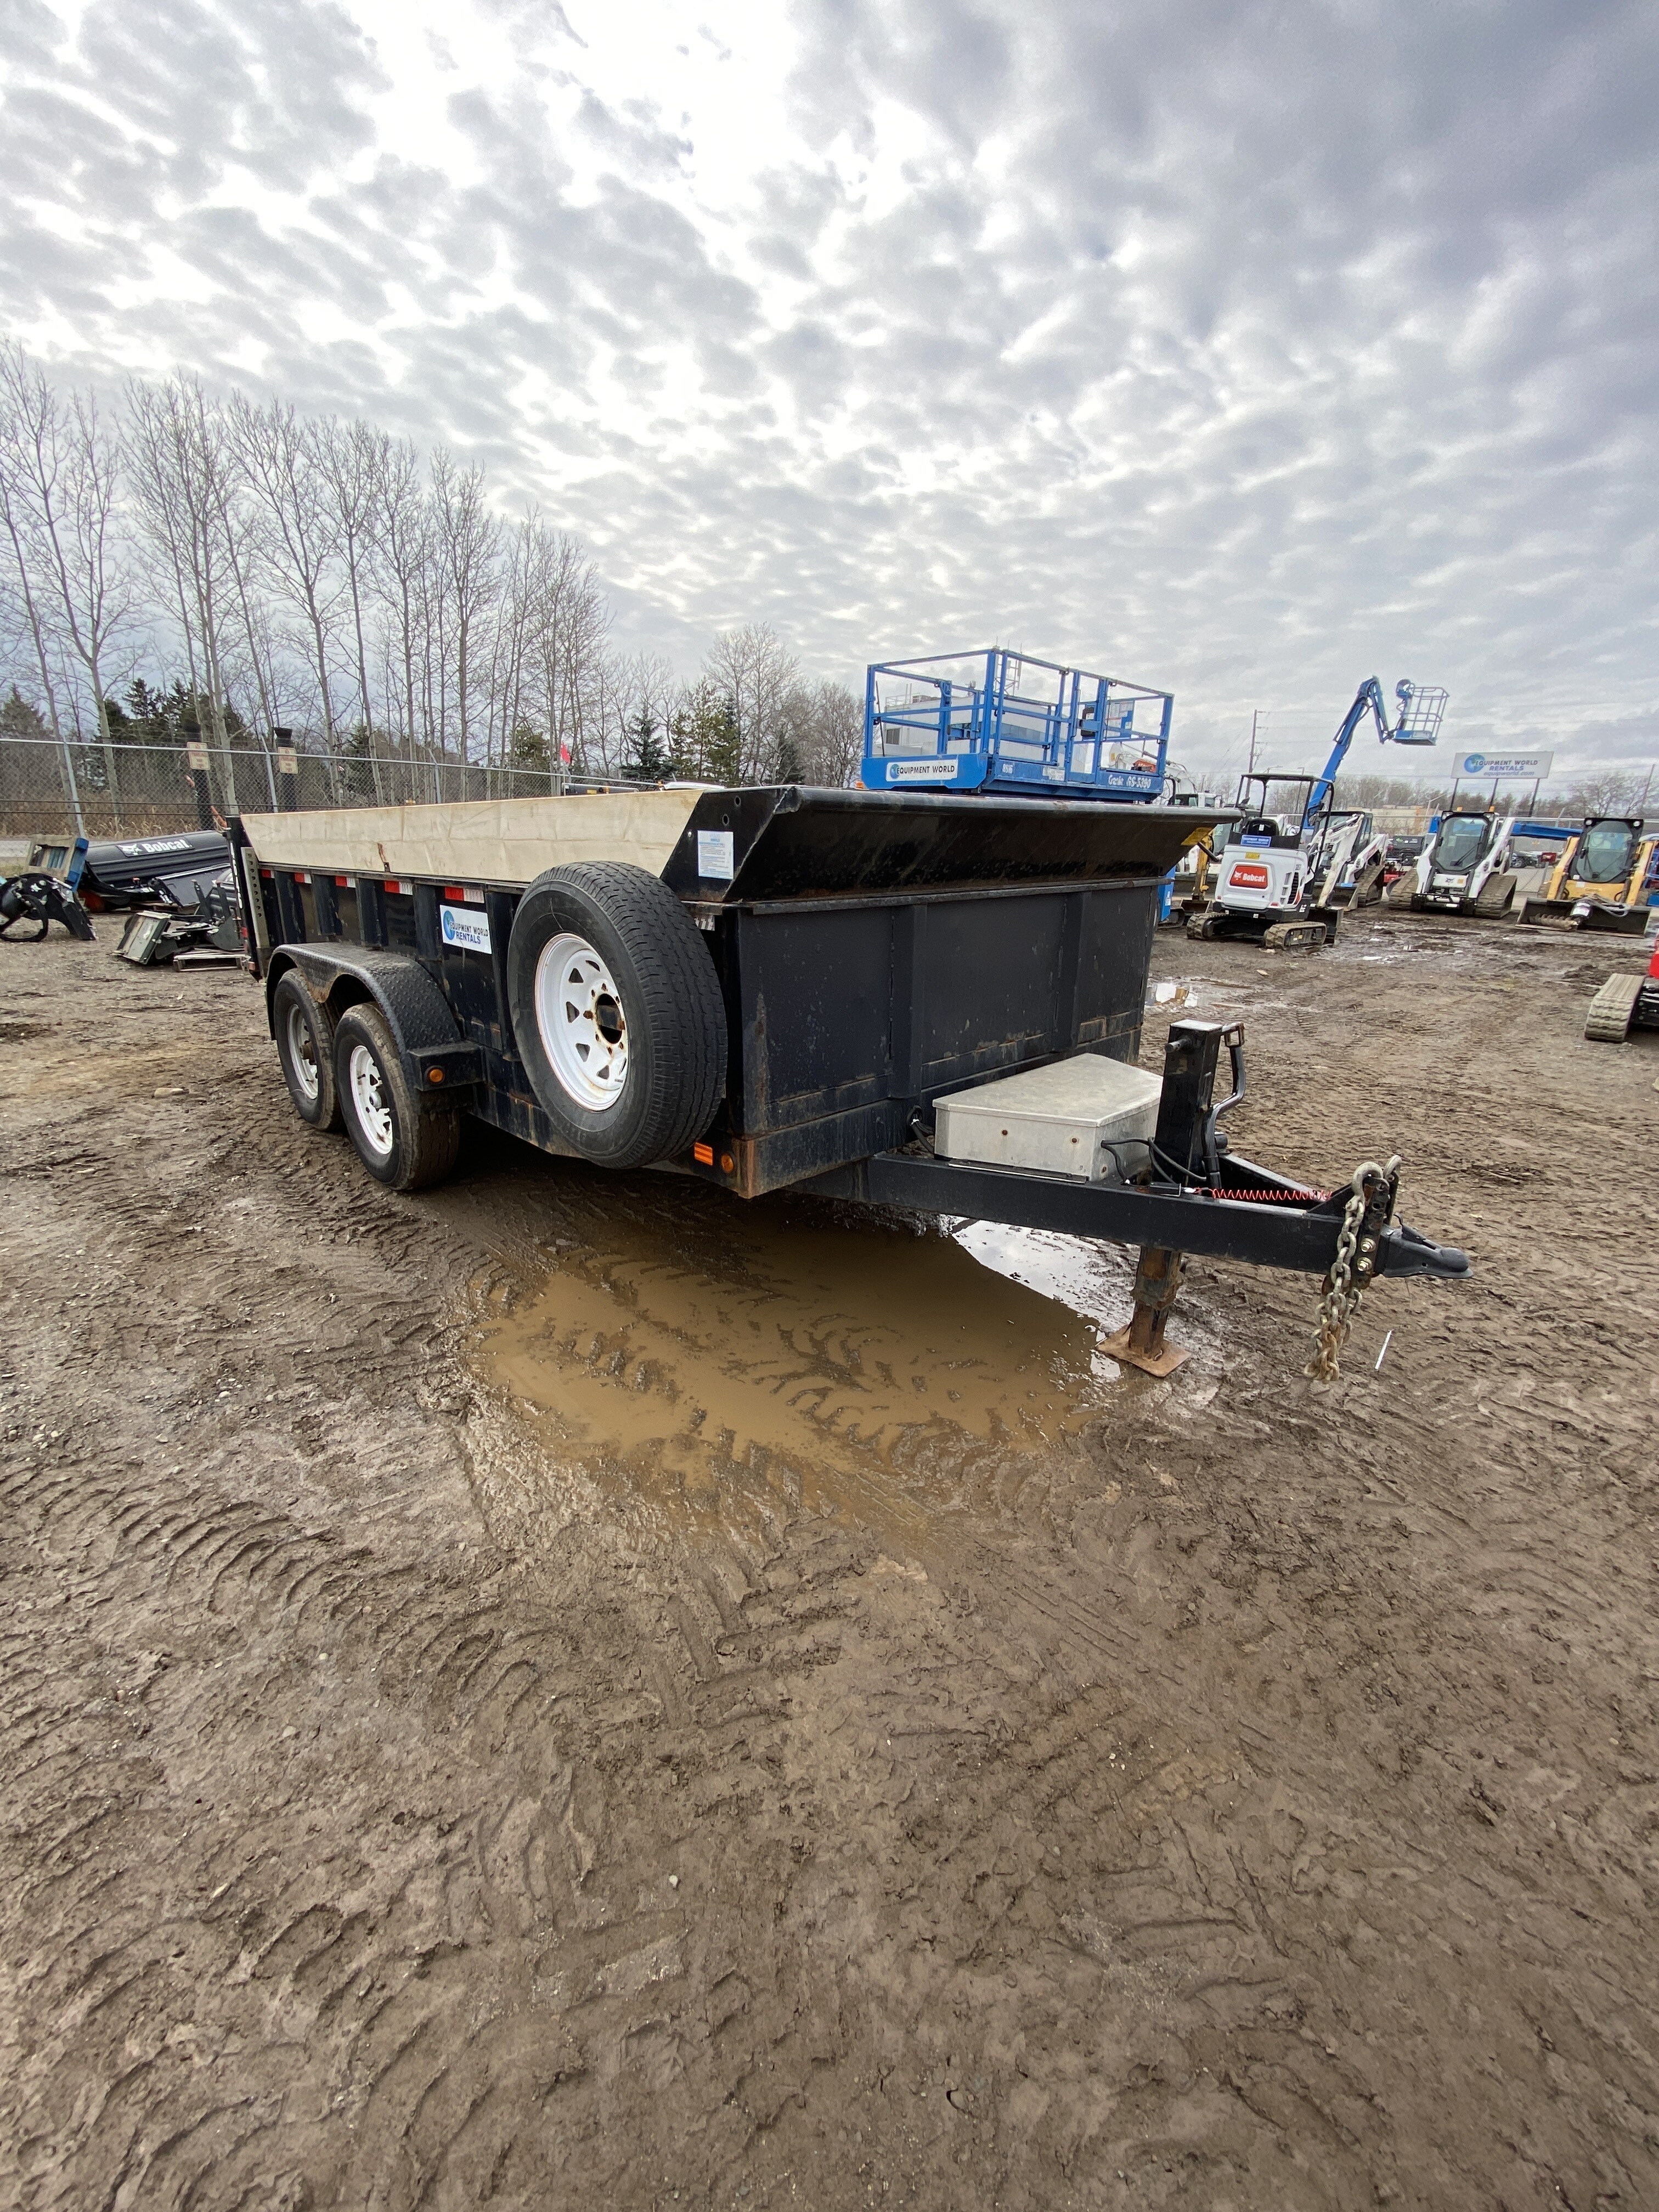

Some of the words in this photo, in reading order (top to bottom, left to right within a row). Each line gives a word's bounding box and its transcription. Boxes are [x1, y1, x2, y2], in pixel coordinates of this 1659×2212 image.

[896, 766, 930, 775] EQUIPMENT
[1242, 873, 1266, 883] Bobcat
[450, 922, 472, 933] EQUIPMENT
[472, 926, 489, 937] WORLD
[456, 931, 481, 944] RENTALS
